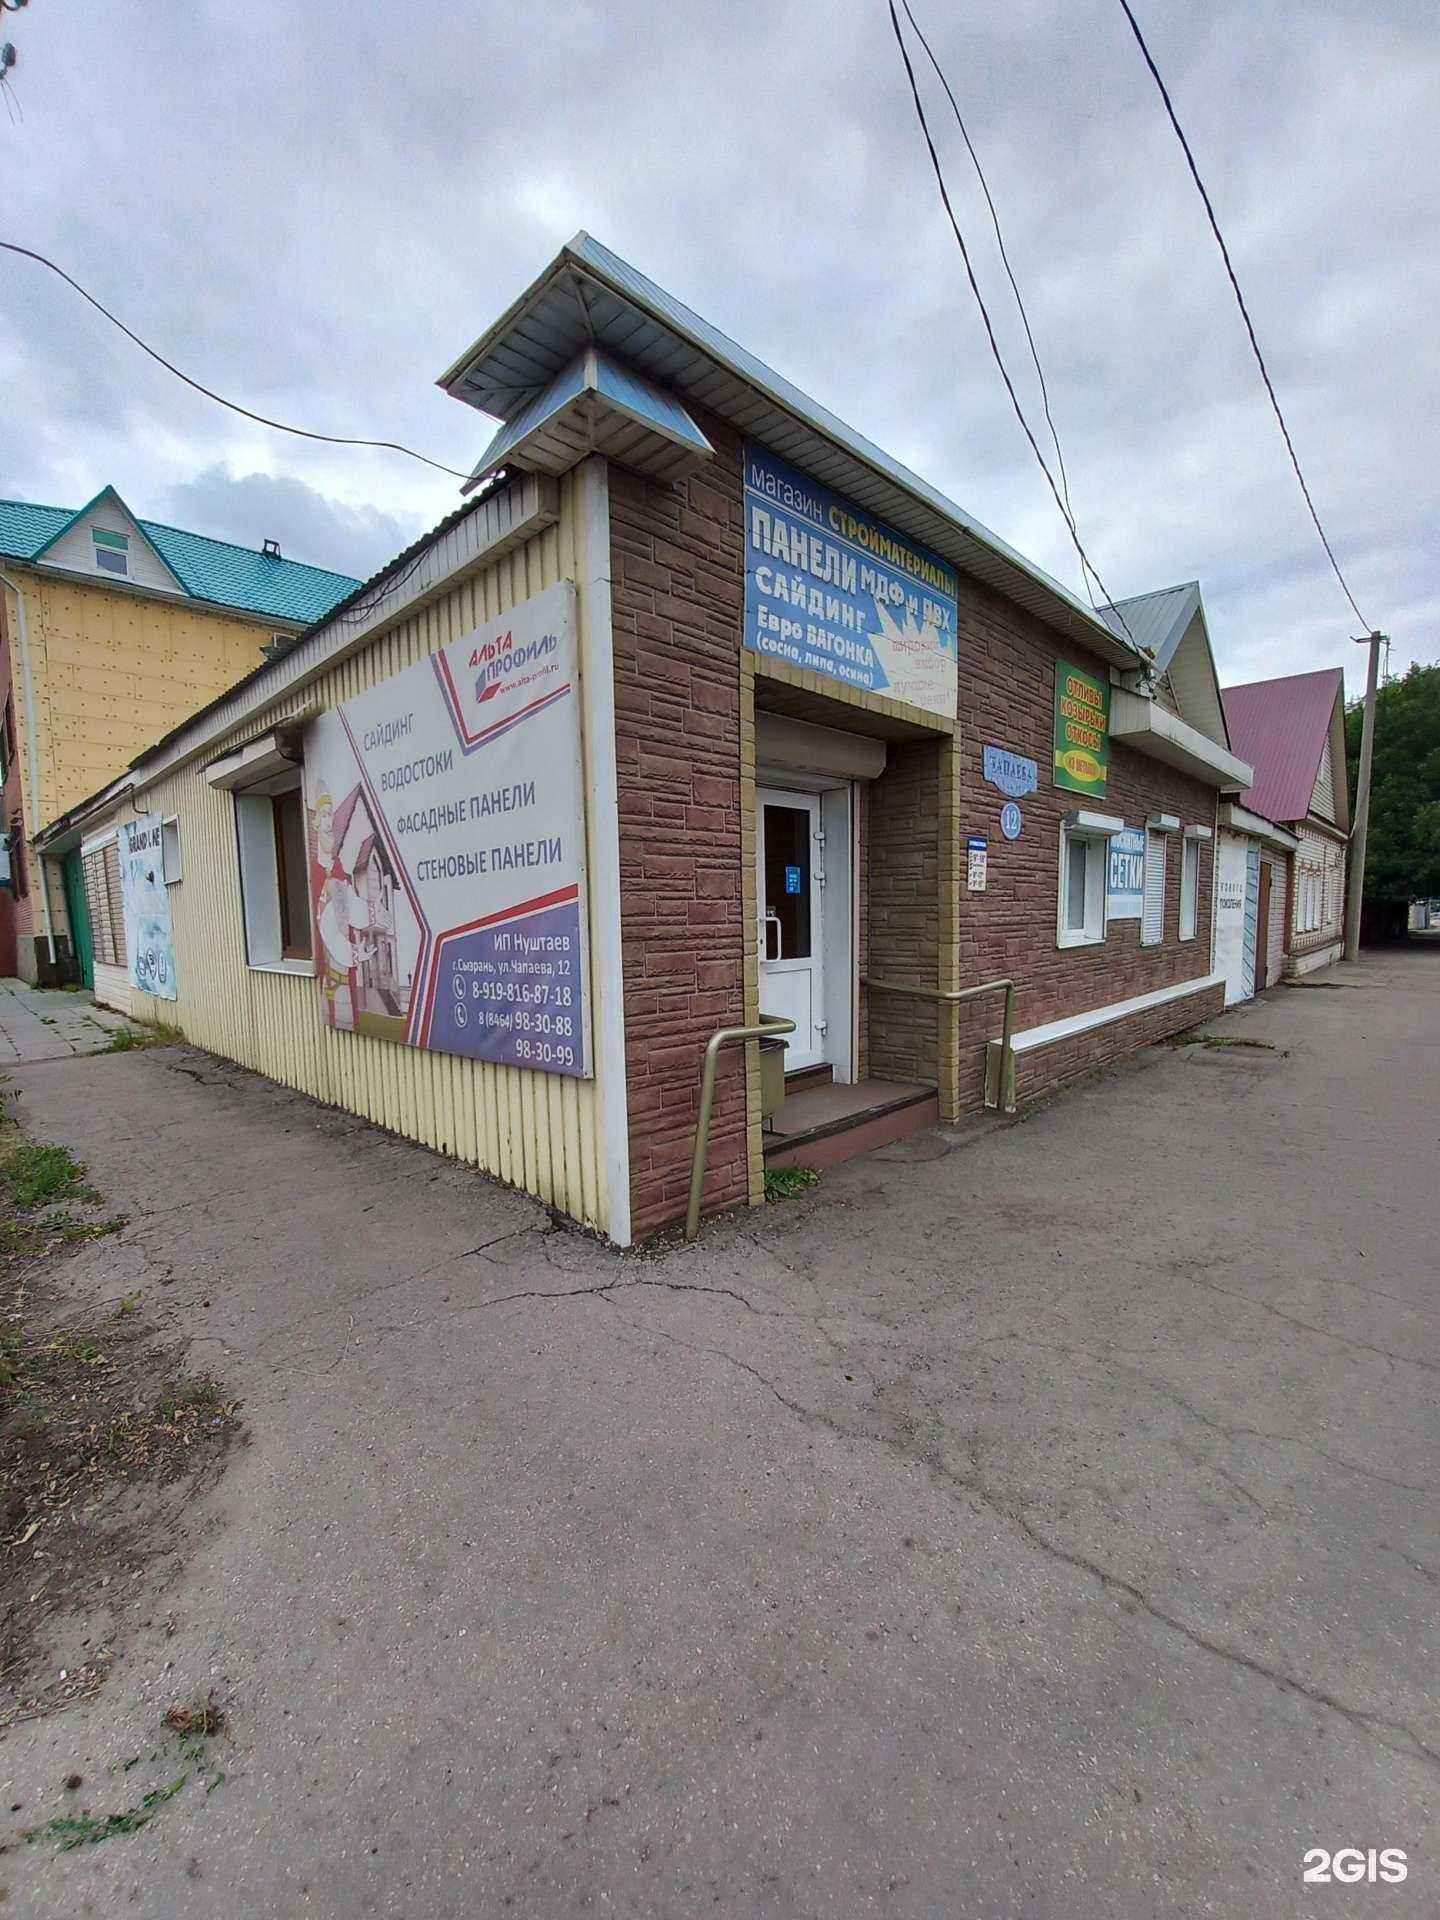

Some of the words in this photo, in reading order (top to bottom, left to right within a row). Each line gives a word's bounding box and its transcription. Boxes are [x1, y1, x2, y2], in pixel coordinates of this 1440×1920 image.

[751, 505, 857, 595] ПАНЕЛИ
[861, 564, 905, 606] МДФ
[922, 597, 951, 630] ПВХ
[829, 505, 956, 596] СТРОЙМАТЕРИАЛЫ
[756, 566, 866, 633] САЙДИНГ
[469, 630, 513, 668] АЛЬТА
[757, 604, 803, 641] Евро
[806, 624, 875, 668] ВАГОНКА
[487, 634, 558, 682] ПРОФИЛЬ
[756, 630, 802, 664] (сосна,
[805, 651, 836, 675] липа,
[839, 664, 874, 688] осина)
[1066, 676, 1103, 709] ОТЛИВЫ
[1061, 695, 1106, 732] КОЗЫРЬКИ
[363, 713, 414, 752] САЙДИНГ
[1066, 722, 1101, 752] ОТКОСЫ
[381, 750, 454, 792] ВОДОСТОКИ
[397, 800, 467, 835] ФАСАДНЫЕ
[470, 781, 536, 820] ПАНЕЛИ
[1006, 810, 1017, 830] 12
[129, 831, 147, 854] GRAND
[147, 827, 160, 849] LNE
[417, 853, 487, 882] СТЕНОВЫЕ
[491, 837, 562, 872] ПАНЕЛИ
[1110, 852, 1143, 889] СЕТКИ
[494, 934, 511, 951] ИП
[514, 934, 570, 955] Нуштаев
[452, 958, 496, 974] г.Сызрань,
[498, 959, 555, 977] ул.Чапаева,
[558, 960, 570, 975] 12
[472, 981, 572, 1006] 8-919-816-87-18
[478, 1012, 484, 1025] 8
[485, 1012, 513, 1031] (8464)
[514, 1012, 572, 1036] 98-30-88
[515, 1039, 574, 1066] 98-30-99
